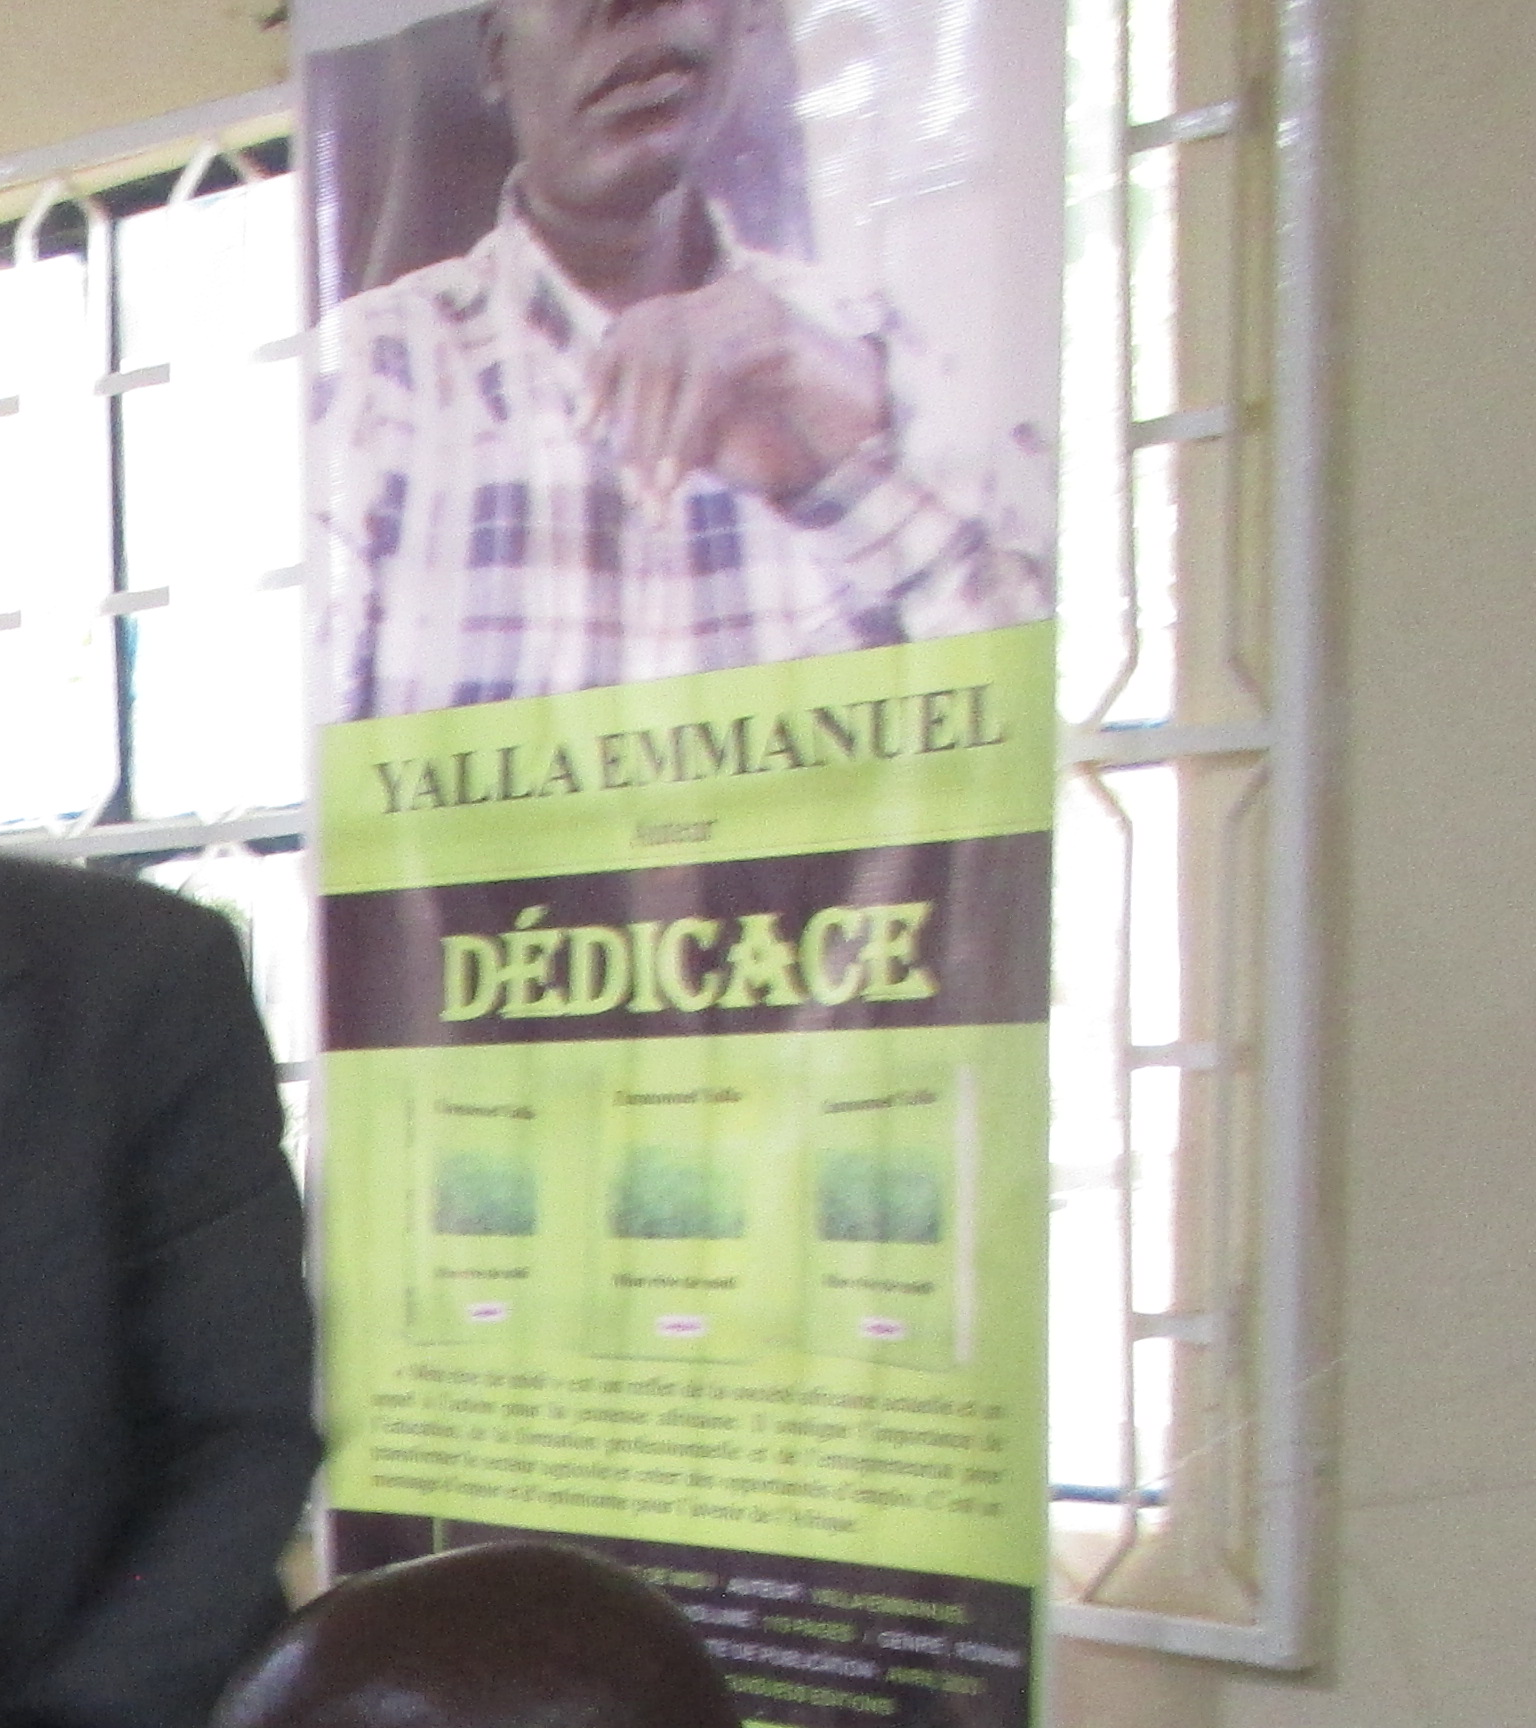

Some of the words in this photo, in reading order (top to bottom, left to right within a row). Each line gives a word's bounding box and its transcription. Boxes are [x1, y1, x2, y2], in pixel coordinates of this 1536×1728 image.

[373, 742, 583, 813] YALLA
[599, 684, 1006, 790] EMMANUEL
[439, 900, 939, 1022] DÉDICACE
